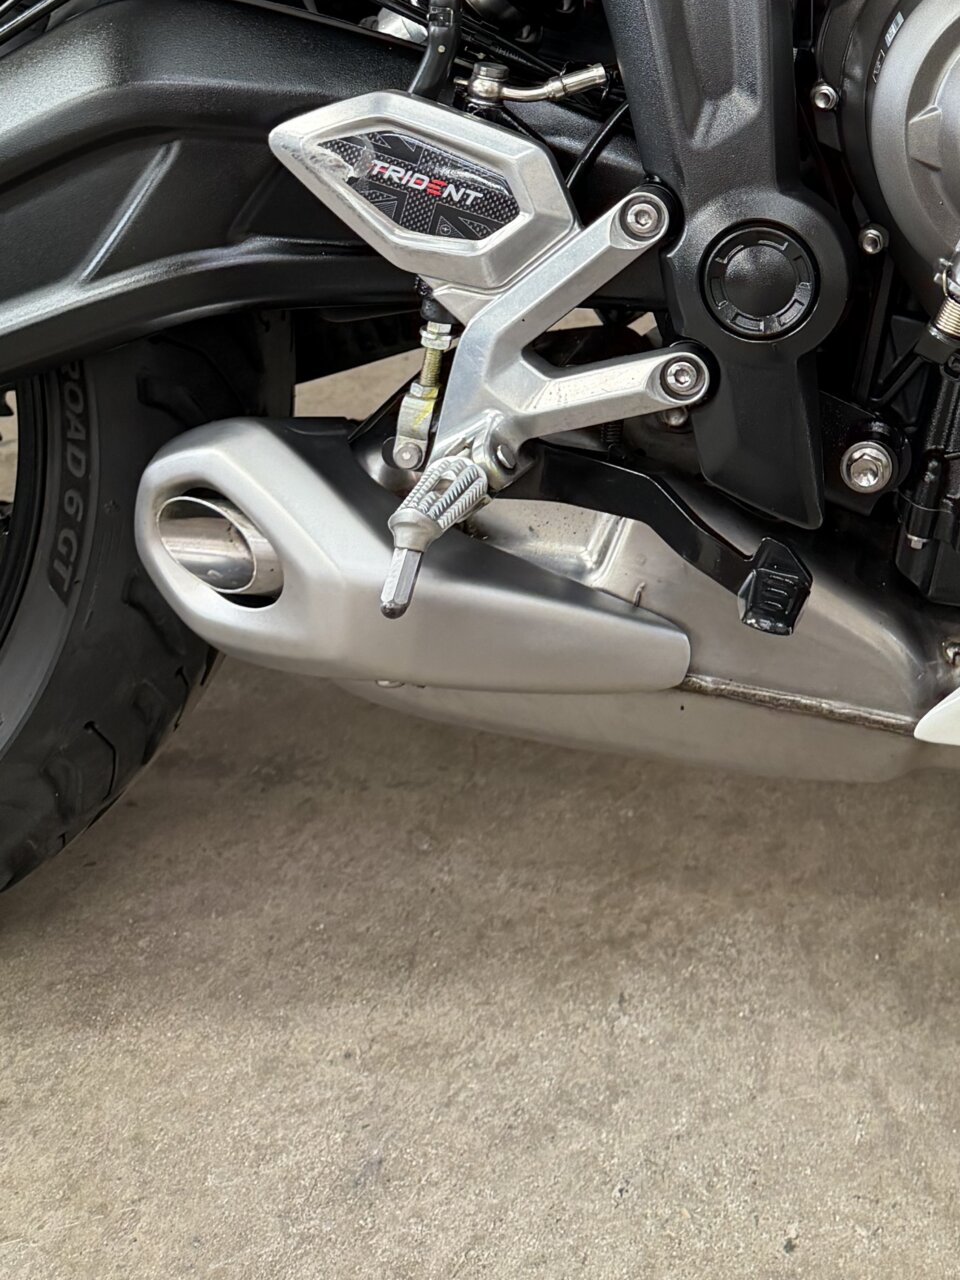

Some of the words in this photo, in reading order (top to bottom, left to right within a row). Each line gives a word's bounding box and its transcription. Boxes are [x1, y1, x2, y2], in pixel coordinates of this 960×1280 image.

[369, 160, 483, 205] TRIDENT
[64, 489, 84, 522] 6
[53, 529, 80, 591] GT
